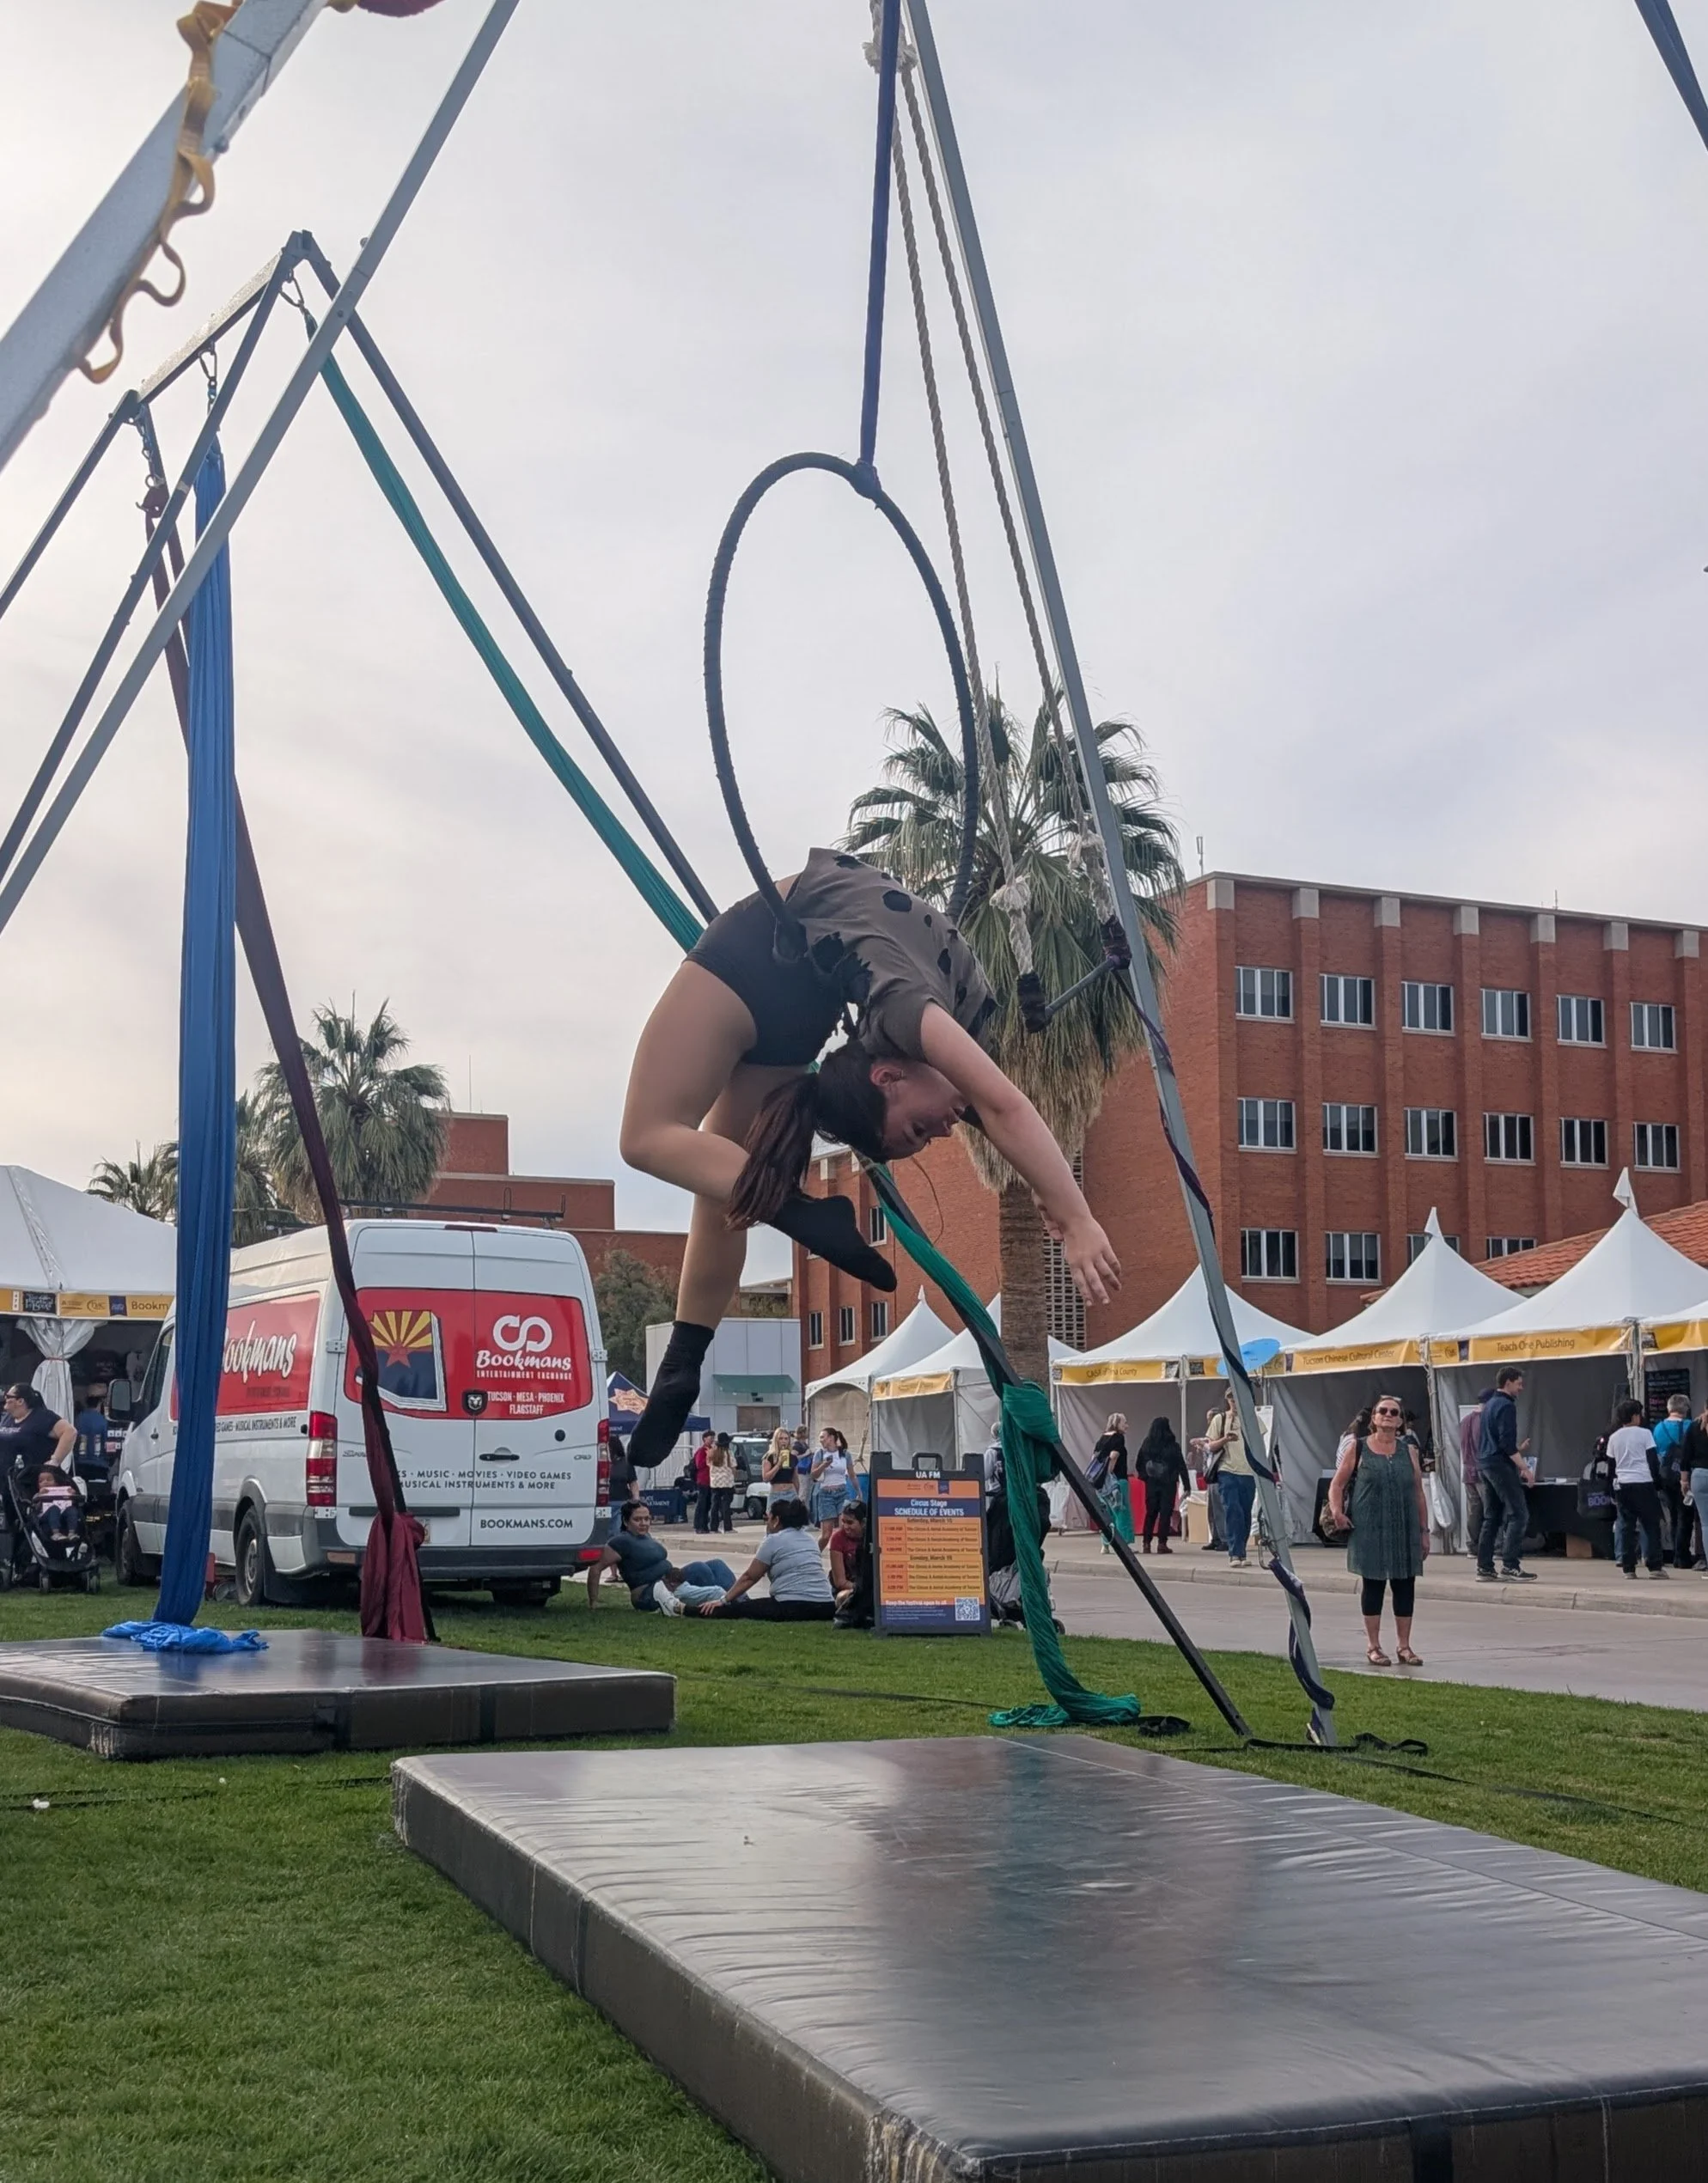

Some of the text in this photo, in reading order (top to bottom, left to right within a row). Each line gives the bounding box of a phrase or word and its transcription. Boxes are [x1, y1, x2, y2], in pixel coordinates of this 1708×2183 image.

[1497, 1341, 1517, 1351] Teach
[1535, 1338, 1575, 1350] Publishing
[223, 1320, 296, 1382] ookmans
[476, 1350, 571, 1370] Bookmans
[1302, 1349, 1395, 1365] Tucson Chinese Cultural Center
[477, 1370, 534, 1379] ENTERTAINMENT
[487, 1392, 564, 1403] TUCSON MESA PHOENIX
[509, 1405, 544, 1415] FLAGSTAFF
[418, 1470, 571, 1480] MUSIC MOVIES VIDEO GAMES
[444, 1481, 515, 1490] INSTRUMENTS
[518, 1481, 524, 1490] &
[528, 1481, 556, 1490] MORE
[930, 1499, 948, 1508] Stage
[480, 1519, 573, 1529] BOOKMANS.COM
